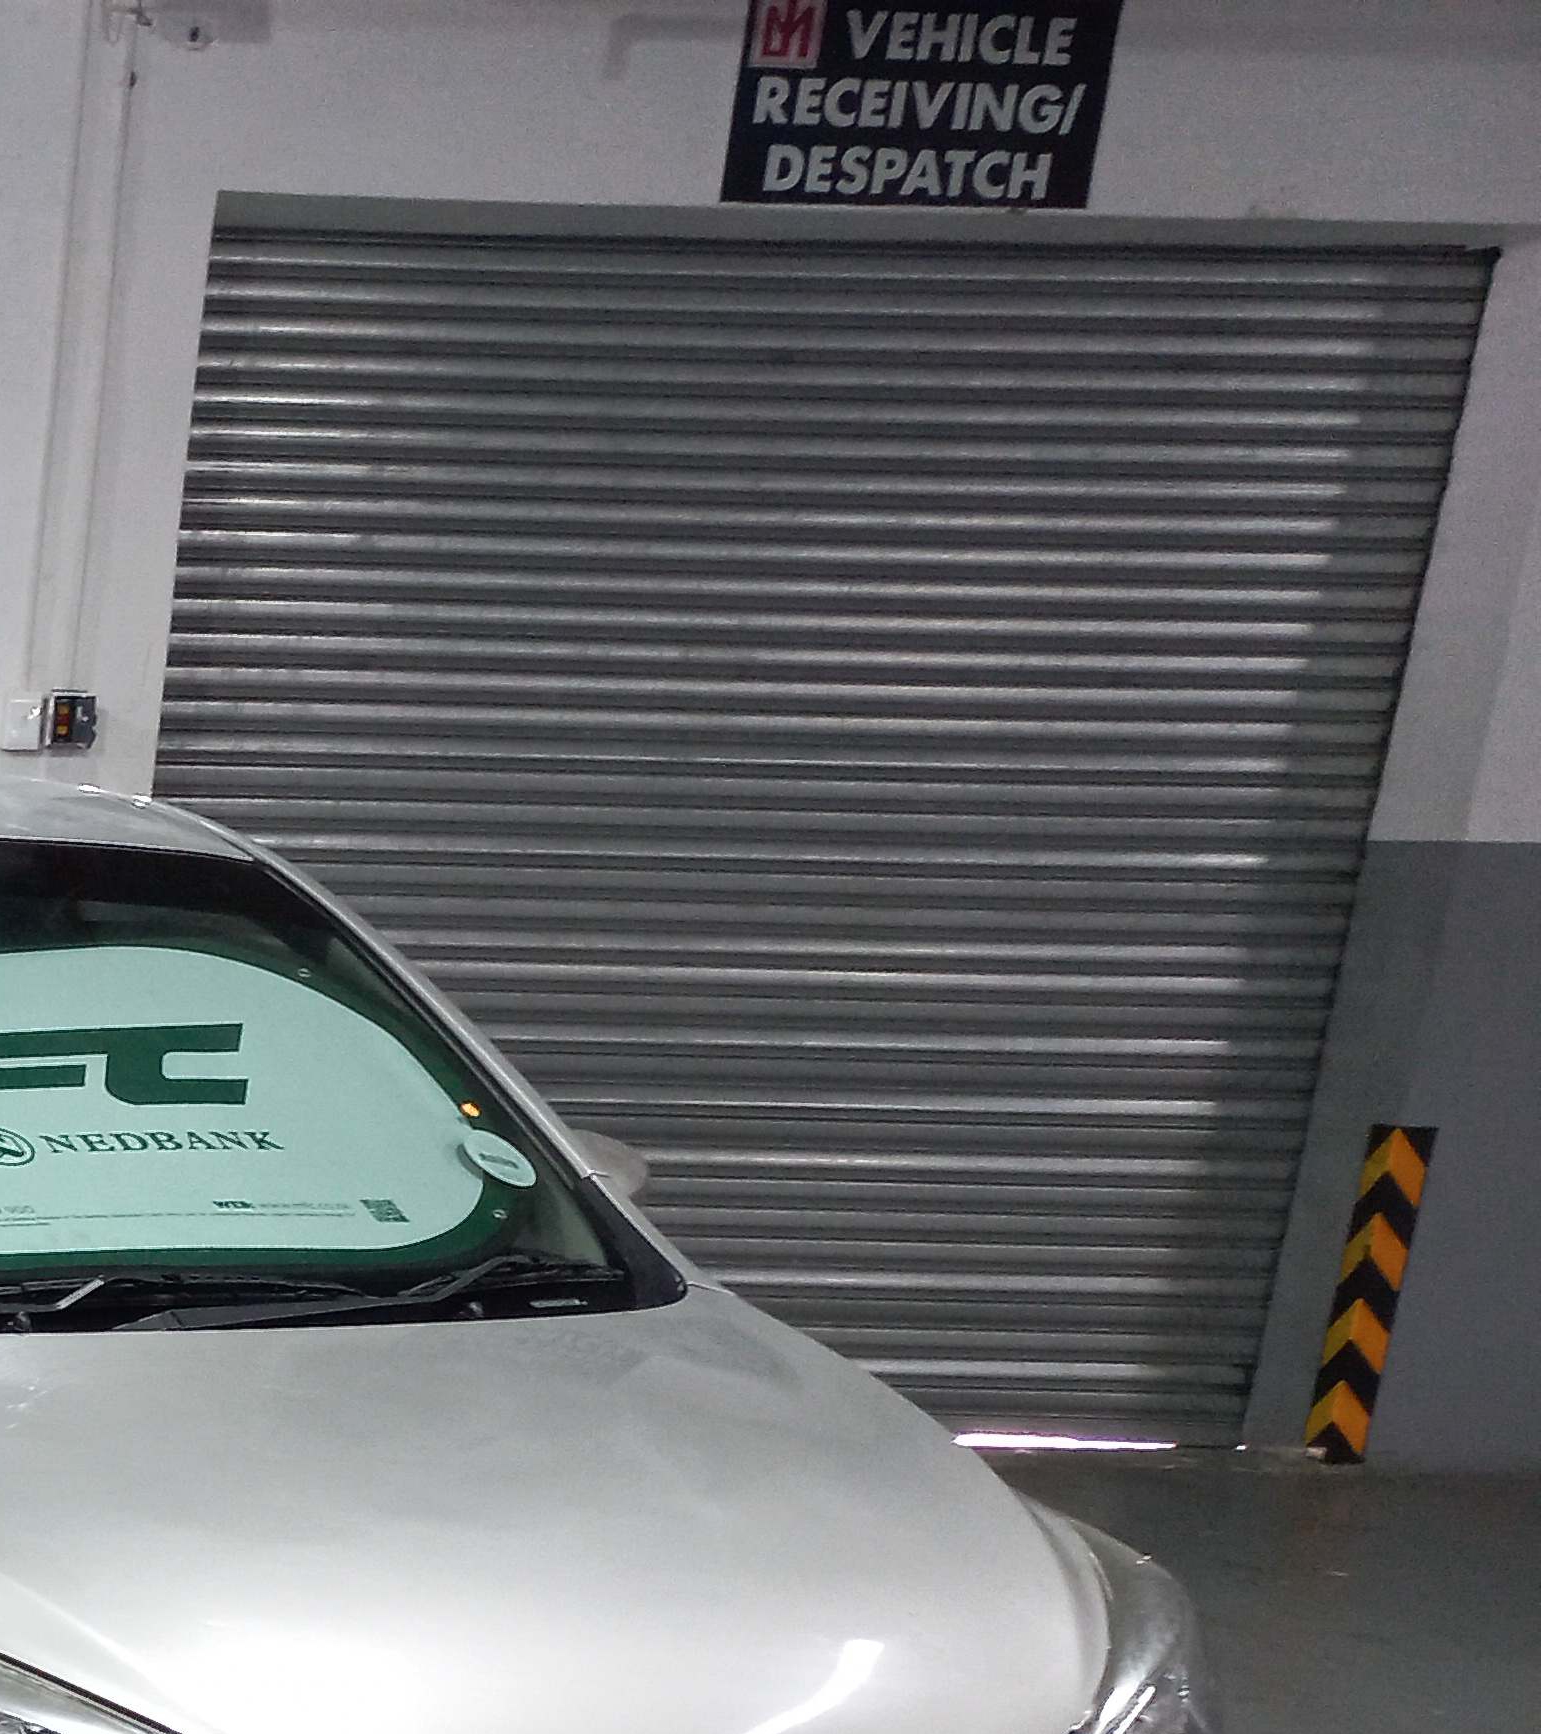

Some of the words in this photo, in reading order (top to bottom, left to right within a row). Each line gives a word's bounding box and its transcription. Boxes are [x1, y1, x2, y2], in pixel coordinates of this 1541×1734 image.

[845, 8, 1078, 66] VEHICLE
[752, 74, 1087, 136] RECEIVING/
[763, 143, 1053, 200] DESPATCH
[39, 1130, 285, 1156] NEDBANK
